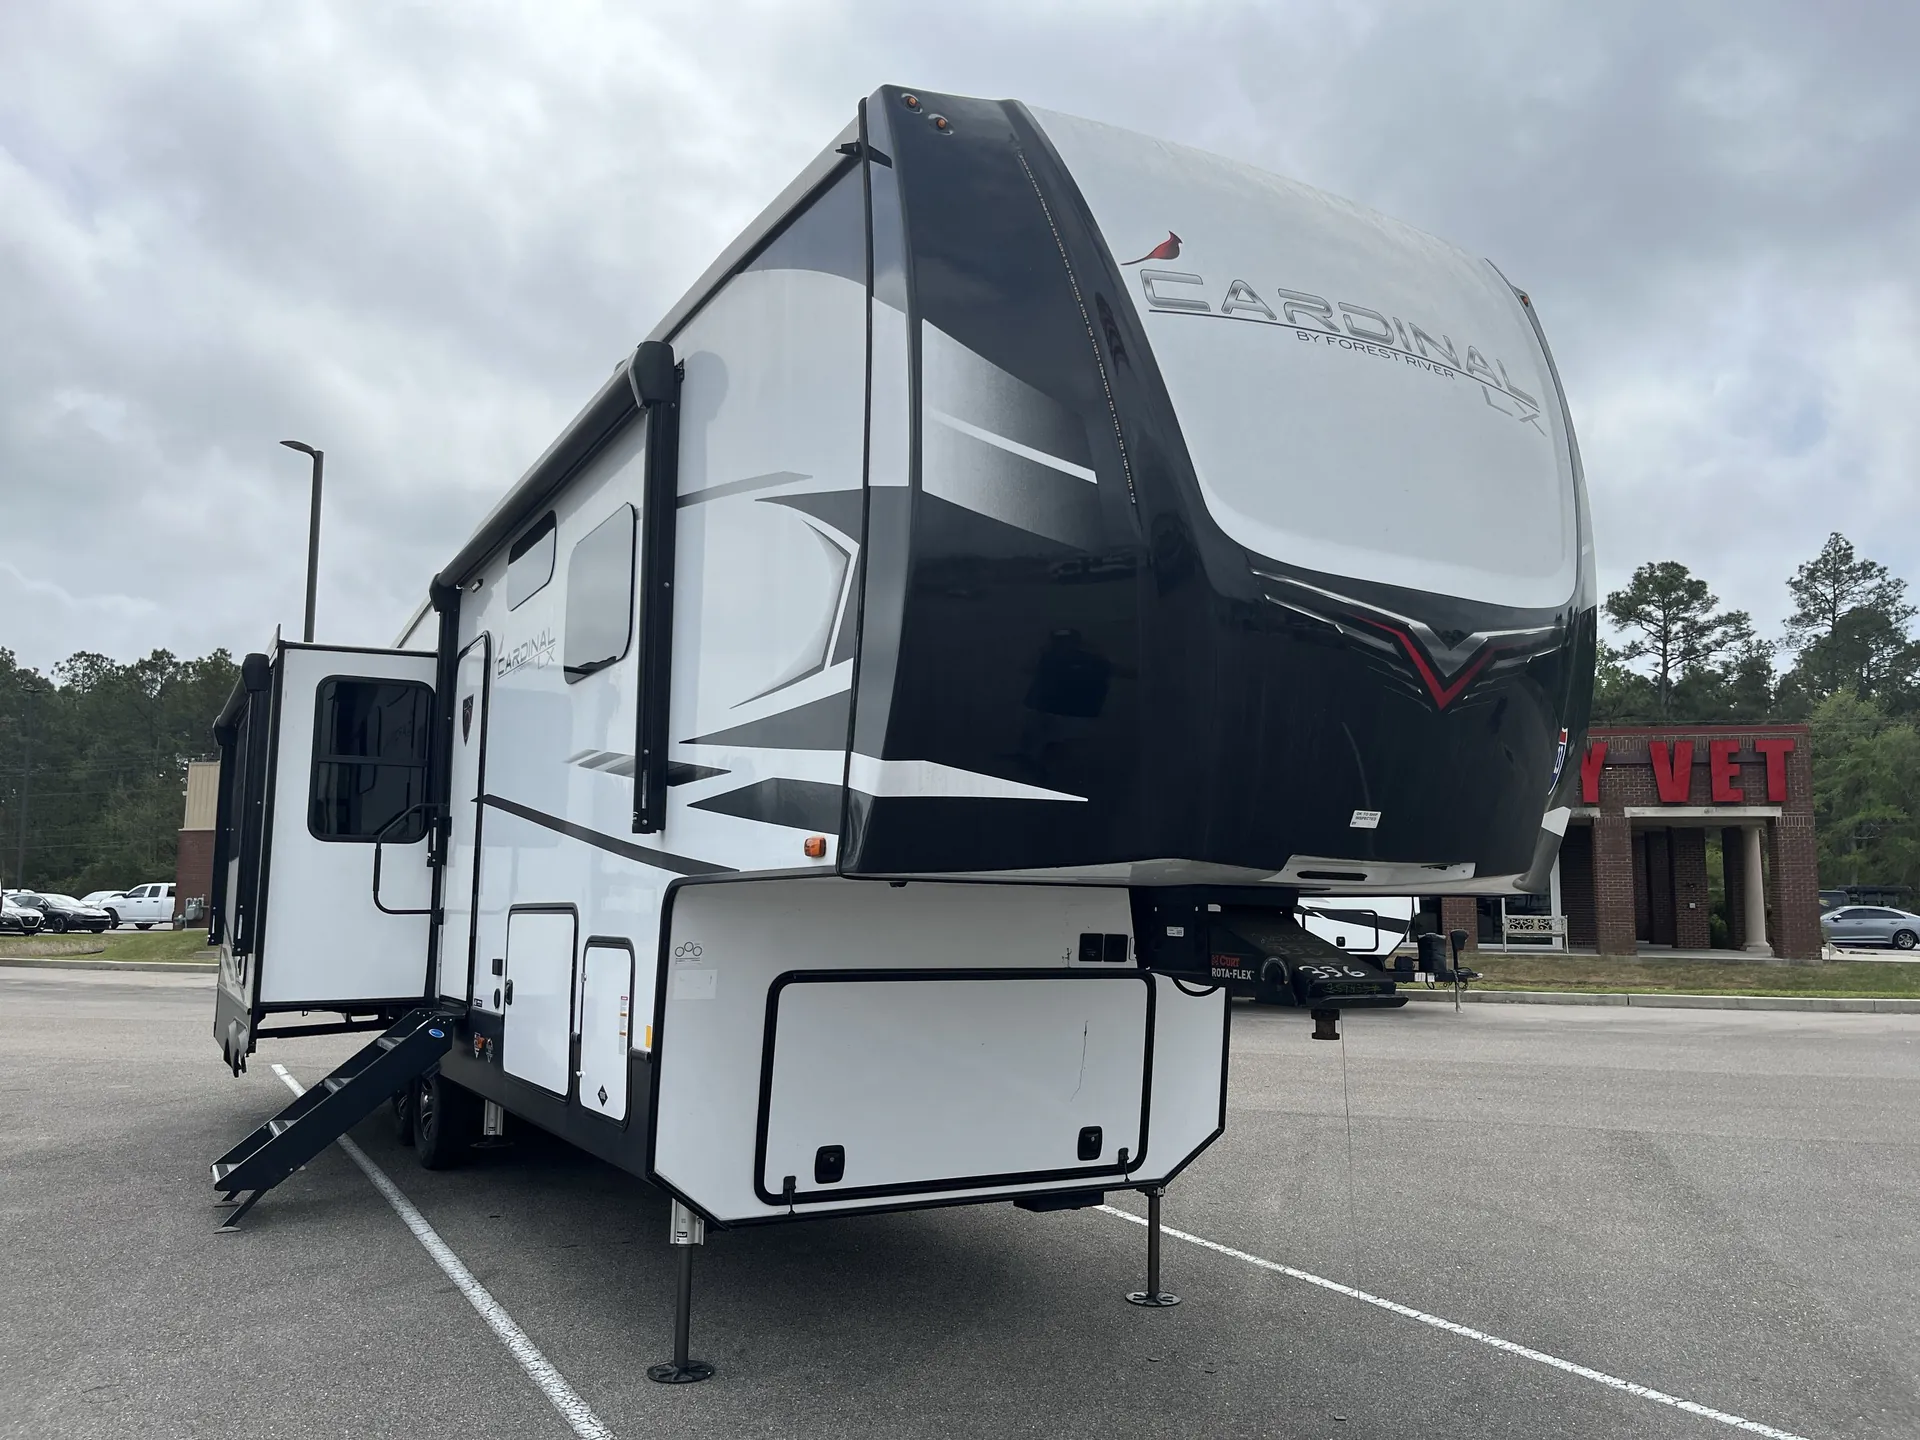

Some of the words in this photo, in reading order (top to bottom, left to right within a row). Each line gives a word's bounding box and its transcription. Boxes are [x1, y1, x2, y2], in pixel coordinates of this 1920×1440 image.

[1140, 269, 1539, 409] CARDINAL
[1296, 331, 1320, 343] BY
[1326, 336, 1400, 361] FOREST
[1405, 355, 1455, 380] RIVER
[1481, 385, 1547, 437] LX
[498, 627, 556, 676] CARDINAL
[537, 646, 555, 670] LX
[1649, 739, 1795, 802] VET
[1298, 965, 1366, 979] 336
